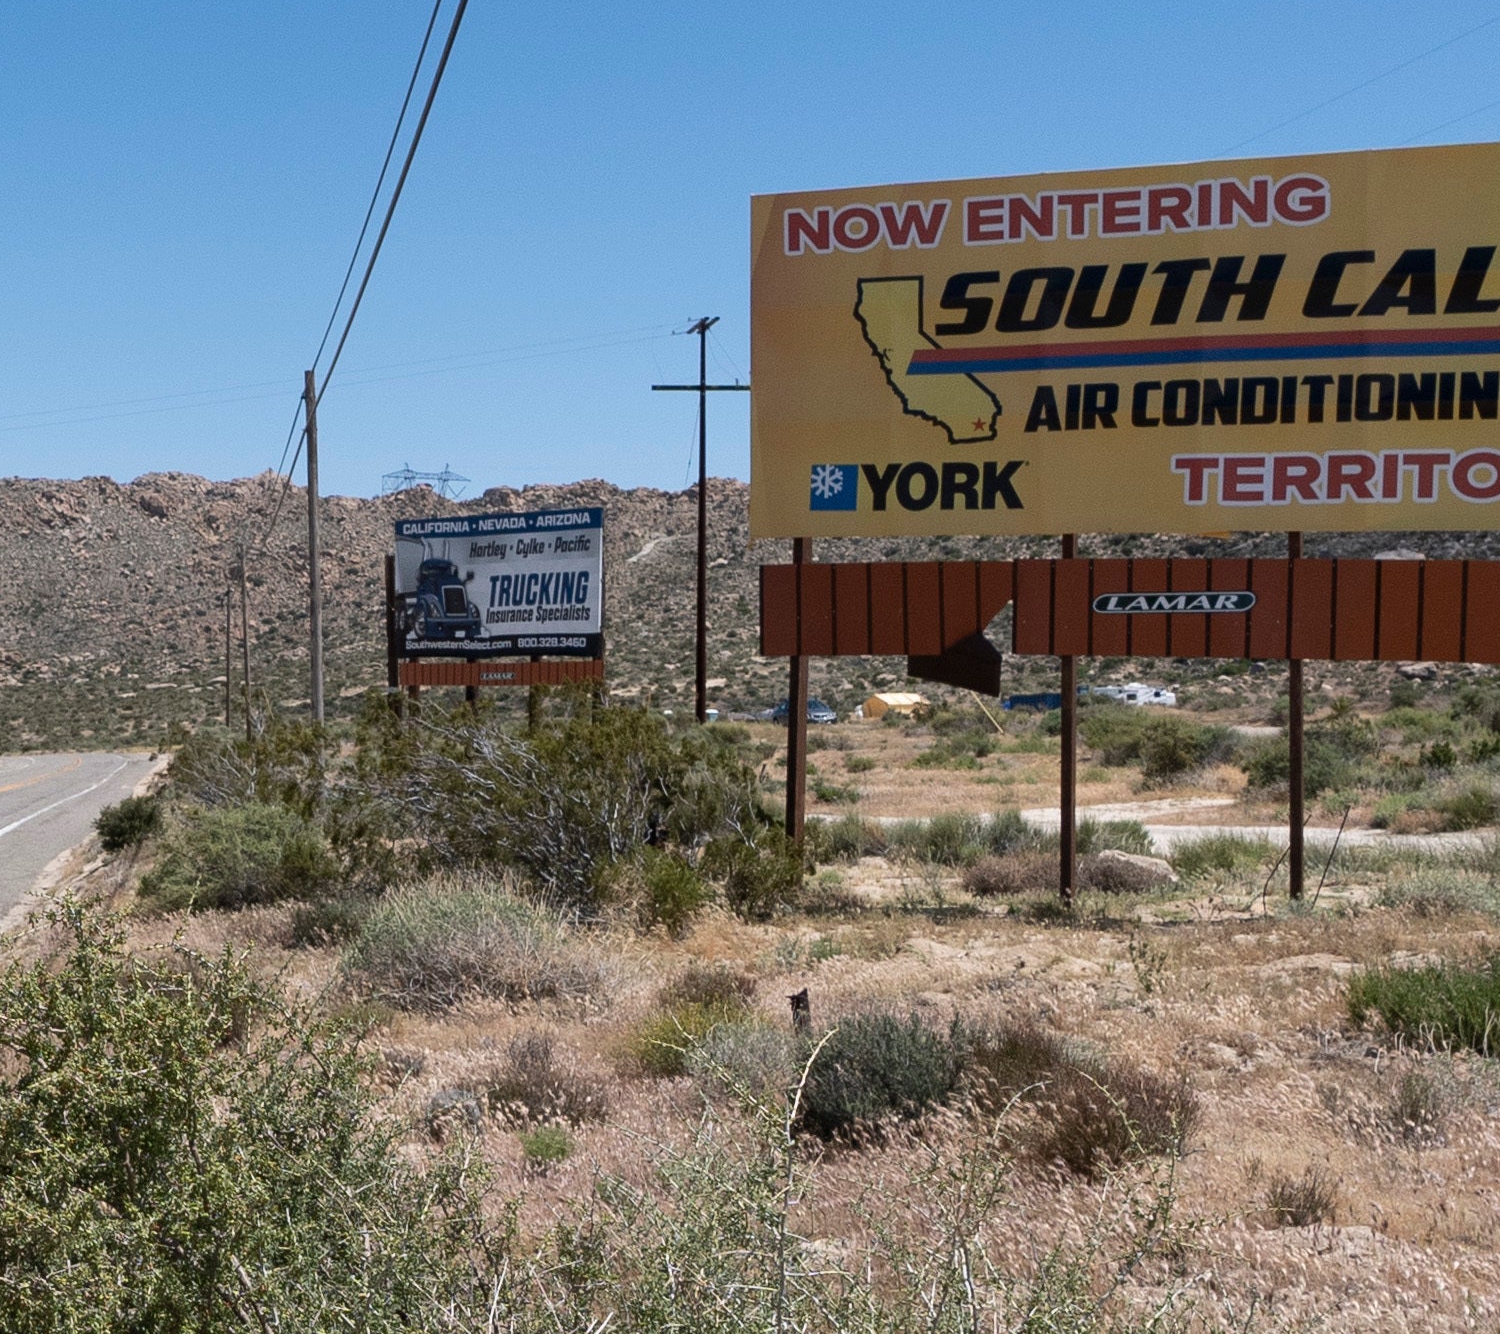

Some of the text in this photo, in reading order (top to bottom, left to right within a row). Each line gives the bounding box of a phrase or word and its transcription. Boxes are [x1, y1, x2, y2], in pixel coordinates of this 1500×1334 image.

[786, 175, 1329, 254] NOW ENTERING
[935, 254, 1287, 336] SOUTH
[1024, 382, 1118, 433] AIR
[861, 460, 1025, 511] YORK
[403, 512, 591, 535] CALIFORNIA NEVADA ARIZONA
[469, 535, 591, 560] Hartley Cylke Pacific
[489, 570, 590, 608] TRUCKING
[1106, 595, 1239, 611] LAMAR
[486, 605, 591, 624] Insurance Specialists
[405, 639, 512, 649] SouthwesternSelect.com
